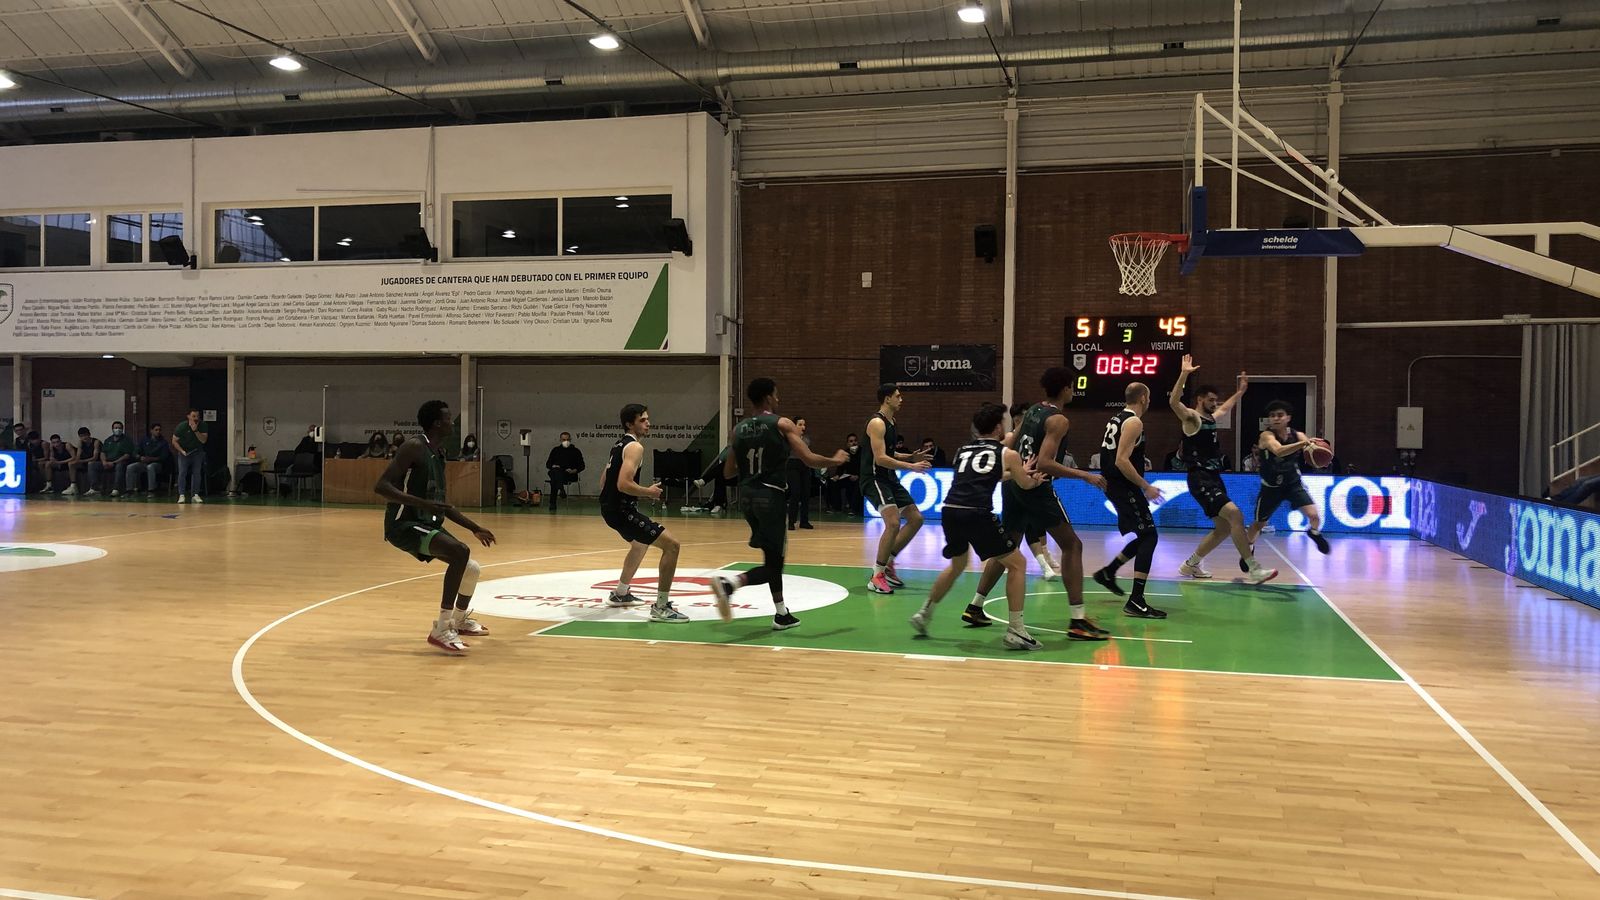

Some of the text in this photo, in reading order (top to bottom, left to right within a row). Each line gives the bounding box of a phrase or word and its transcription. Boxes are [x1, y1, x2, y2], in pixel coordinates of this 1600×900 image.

[381, 277, 424, 285] JUGADORES
[437, 276, 473, 284] CANTERA
[474, 275, 490, 284] QUE
[511, 274, 553, 282] DEBUTADO
[554, 273, 572, 281] CON
[585, 272, 616, 280] PRIMER
[618, 271, 648, 280] EQUIPO
[1077, 318, 1104, 337] 51
[1159, 317, 1186, 336] 45
[1122, 329, 1132, 342] 3
[1070, 343, 1103, 352] LOCAL
[1151, 342, 1184, 350] VISITANTE
[1096, 356, 1158, 374] 08:22
[1077, 376, 1087, 389] 0
[746, 447, 764, 475] 11
[958, 450, 996, 474] 10
[494, 594, 602, 602] COSTA
